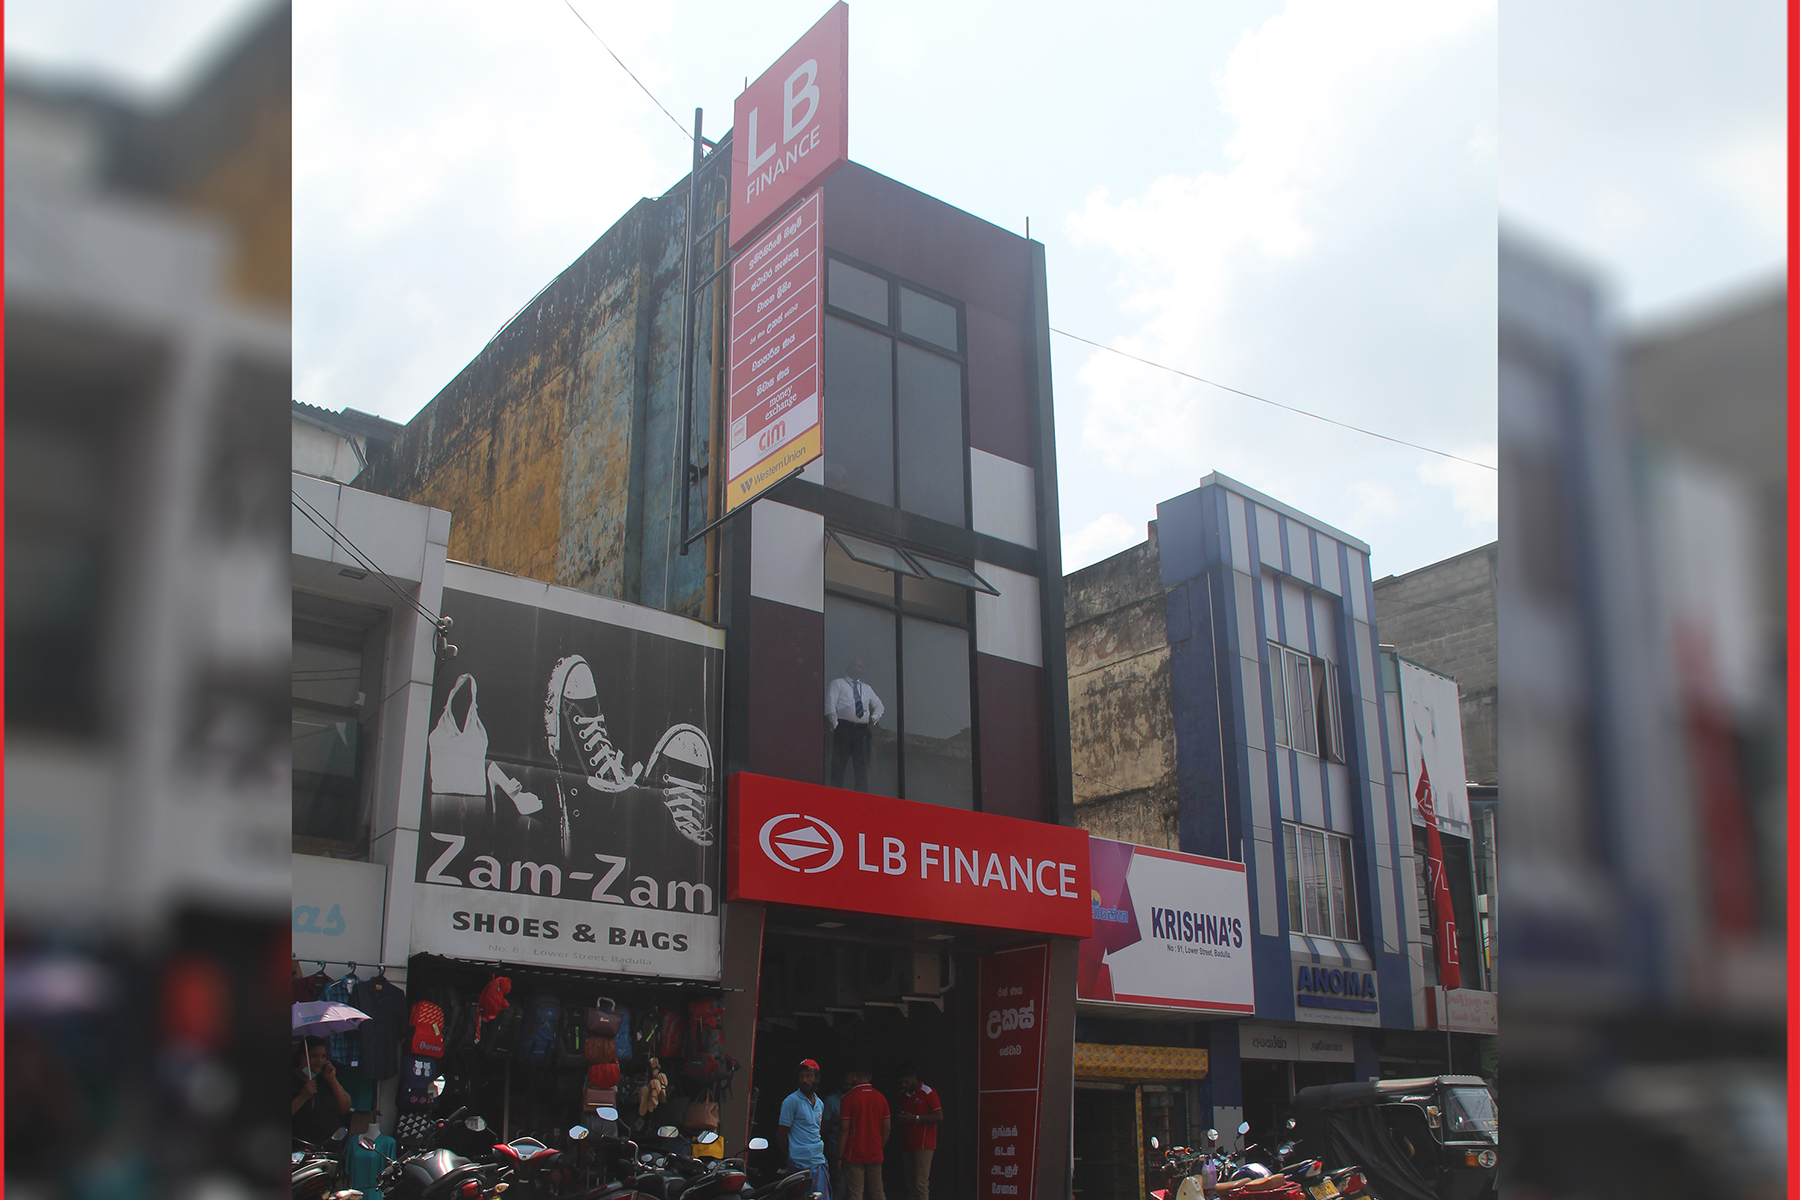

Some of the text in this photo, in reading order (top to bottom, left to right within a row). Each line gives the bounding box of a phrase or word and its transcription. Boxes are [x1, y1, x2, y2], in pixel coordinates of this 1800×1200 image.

[748, 58, 820, 177] LB
[747, 124, 820, 204] FINANCE
[765, 392, 797, 421] exchange
[769, 385, 793, 408] money
[426, 831, 713, 916] Zam-Zam
[858, 832, 1079, 899] LB FINANCE
[452, 910, 689, 952] SHOES & BAGS
[1151, 906, 1243, 949] KRISHNA'S
[488, 943, 508, 953] No.
[533, 948, 569, 959] Lower
[572, 952, 608, 963] Street,
[610, 955, 655, 967] Badulla.
[1185, 946, 1198, 956] Lower
[997, 986, 1023, 997] රන් ණය
[1298, 965, 1377, 999] ANOMA
[986, 999, 1035, 1040] උකස්
[999, 1044, 1022, 1056] සේවාව
[991, 1125, 1018, 1140] தங்கக்
[994, 1144, 1015, 1157] கடன்
[991, 1182, 1018, 1195] சேவை
